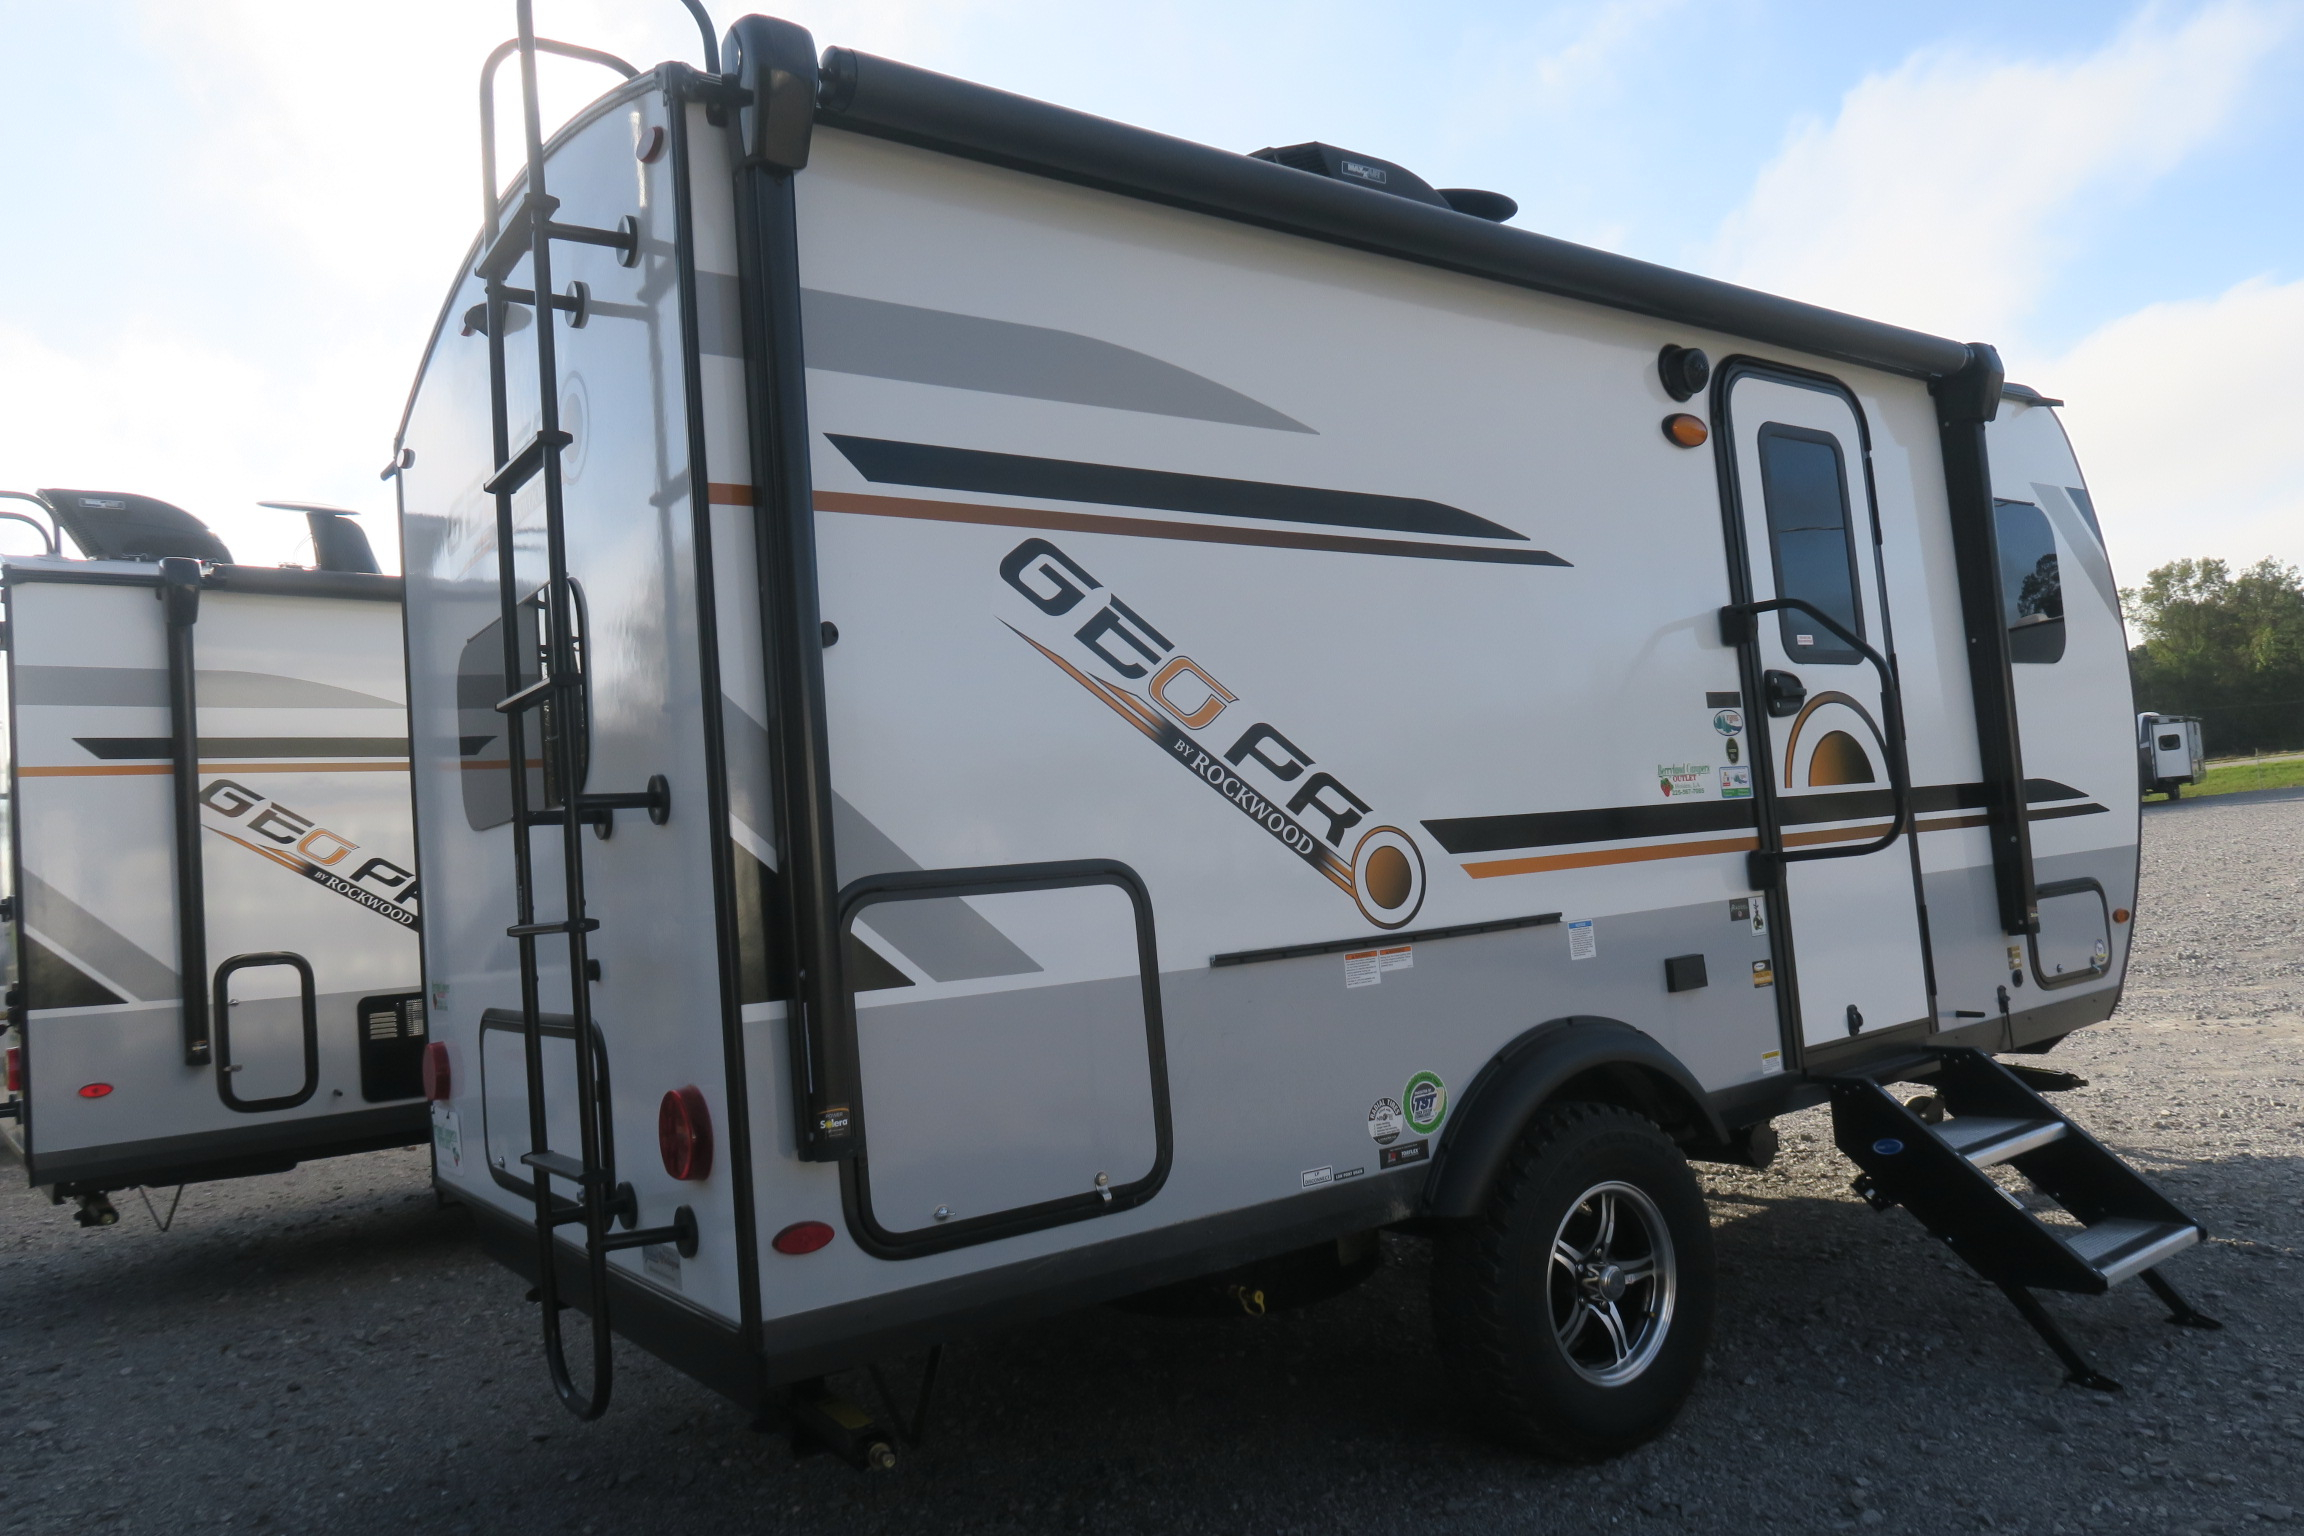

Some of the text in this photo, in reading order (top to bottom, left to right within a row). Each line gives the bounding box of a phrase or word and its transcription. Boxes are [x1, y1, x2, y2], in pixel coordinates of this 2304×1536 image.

[999, 537, 1240, 731] GEO
[199, 779, 360, 867] GEO
[1174, 738, 1314, 855] BY ROCKWOOD
[314, 871, 413, 925] BY ROCKWOOD
[820, 1118, 848, 1129] Solera
[1370, 1098, 1386, 1119] RADIAL
[1387, 1098, 1401, 1115] TIRES
[1414, 1093, 1437, 1111] TST
